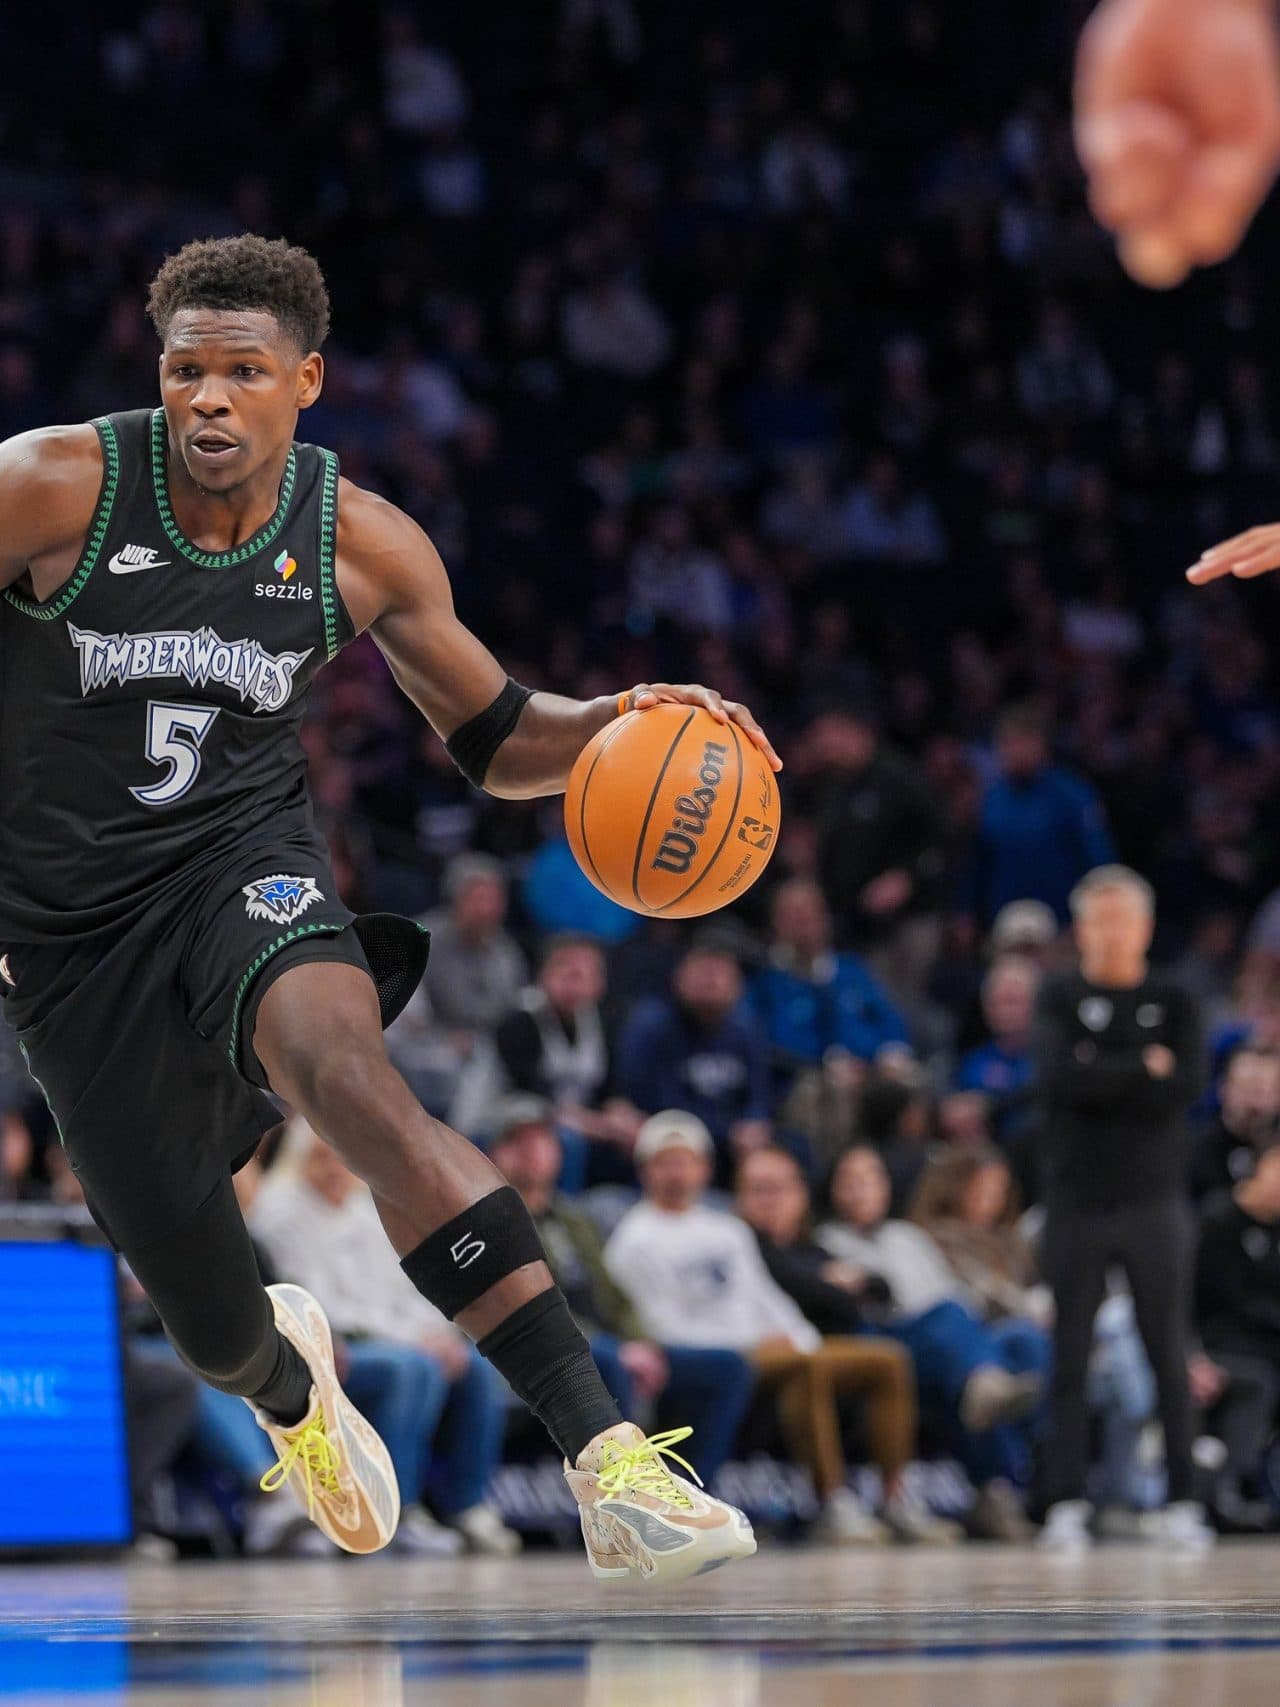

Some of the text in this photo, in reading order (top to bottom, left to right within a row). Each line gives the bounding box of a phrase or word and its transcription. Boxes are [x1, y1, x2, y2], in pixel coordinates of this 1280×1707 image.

[119, 543, 159, 565] NIKE
[254, 581, 314, 601] sezzle
[66, 620, 316, 714] TIMBERWOLVES
[127, 700, 222, 806] 5
[651, 740, 729, 876] Wilson
[449, 1231, 486, 1270] 5
